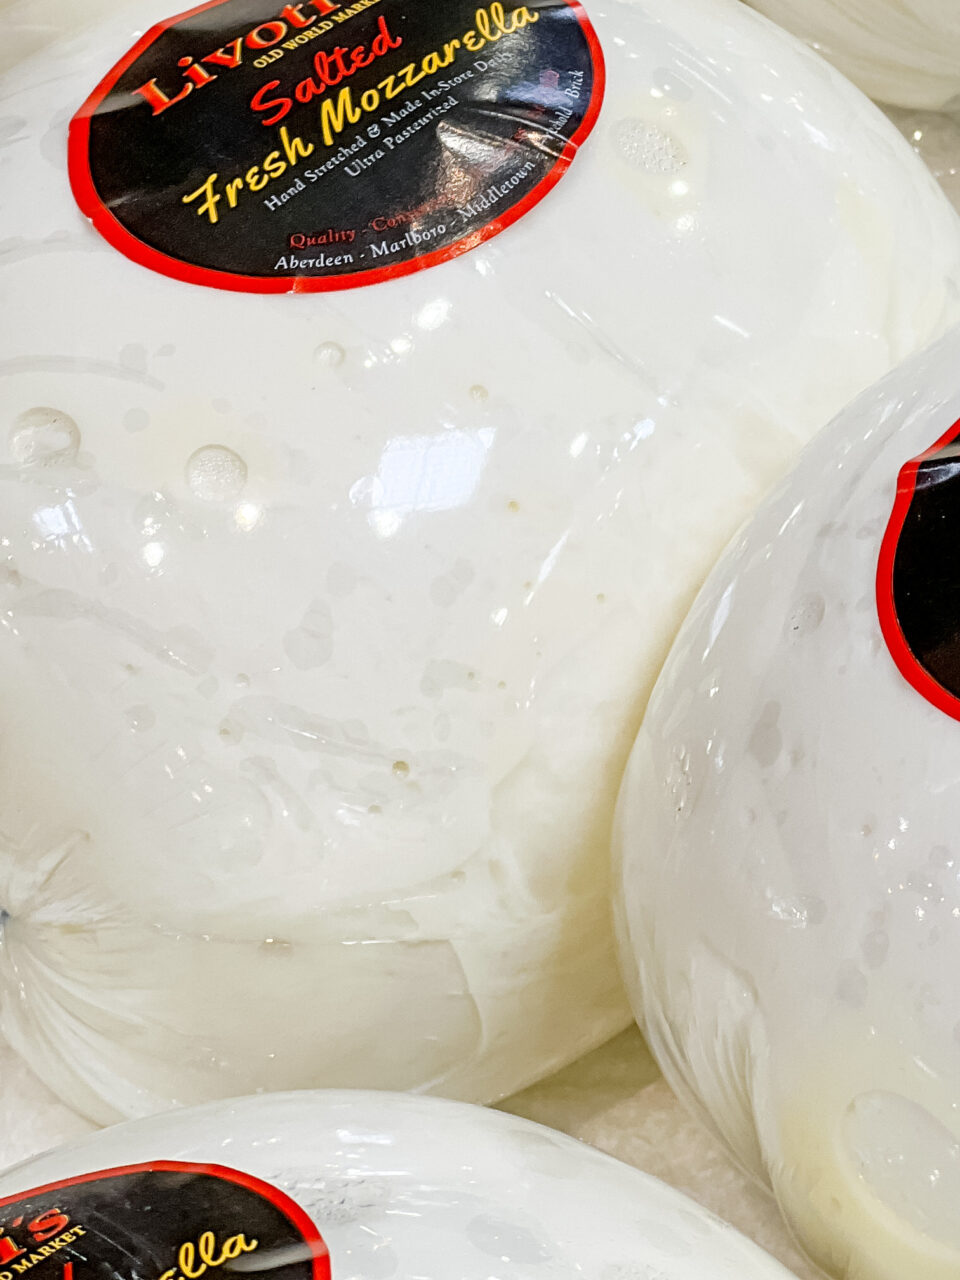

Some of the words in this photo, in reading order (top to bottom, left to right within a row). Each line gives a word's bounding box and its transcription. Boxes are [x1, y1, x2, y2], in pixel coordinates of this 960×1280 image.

[250, 15, 402, 126] Salted
[253, 48, 284, 68] OLD
[282, 20, 334, 50] WORLD
[182, 126, 315, 224] Fresh
[320, 1, 539, 146] Mozzarella
[263, 181, 306, 213] Hand
[308, 138, 367, 182] Stretched
[368, 123, 382, 139] &
[380, 97, 423, 127] Made
[421, 68, 474, 99] In-Store
[343, 150, 385, 179] Ultra
[383, 95, 460, 150] Pasteurized
[274, 253, 354, 270] Aberdeen
[369, 223, 447, 258] Marlboro
[456, 161, 535, 223] Middletown
[564, 69, 585, 99] Brick
[289, 228, 356, 249] Quality
[10, 1225, 86, 1273] MARKET
